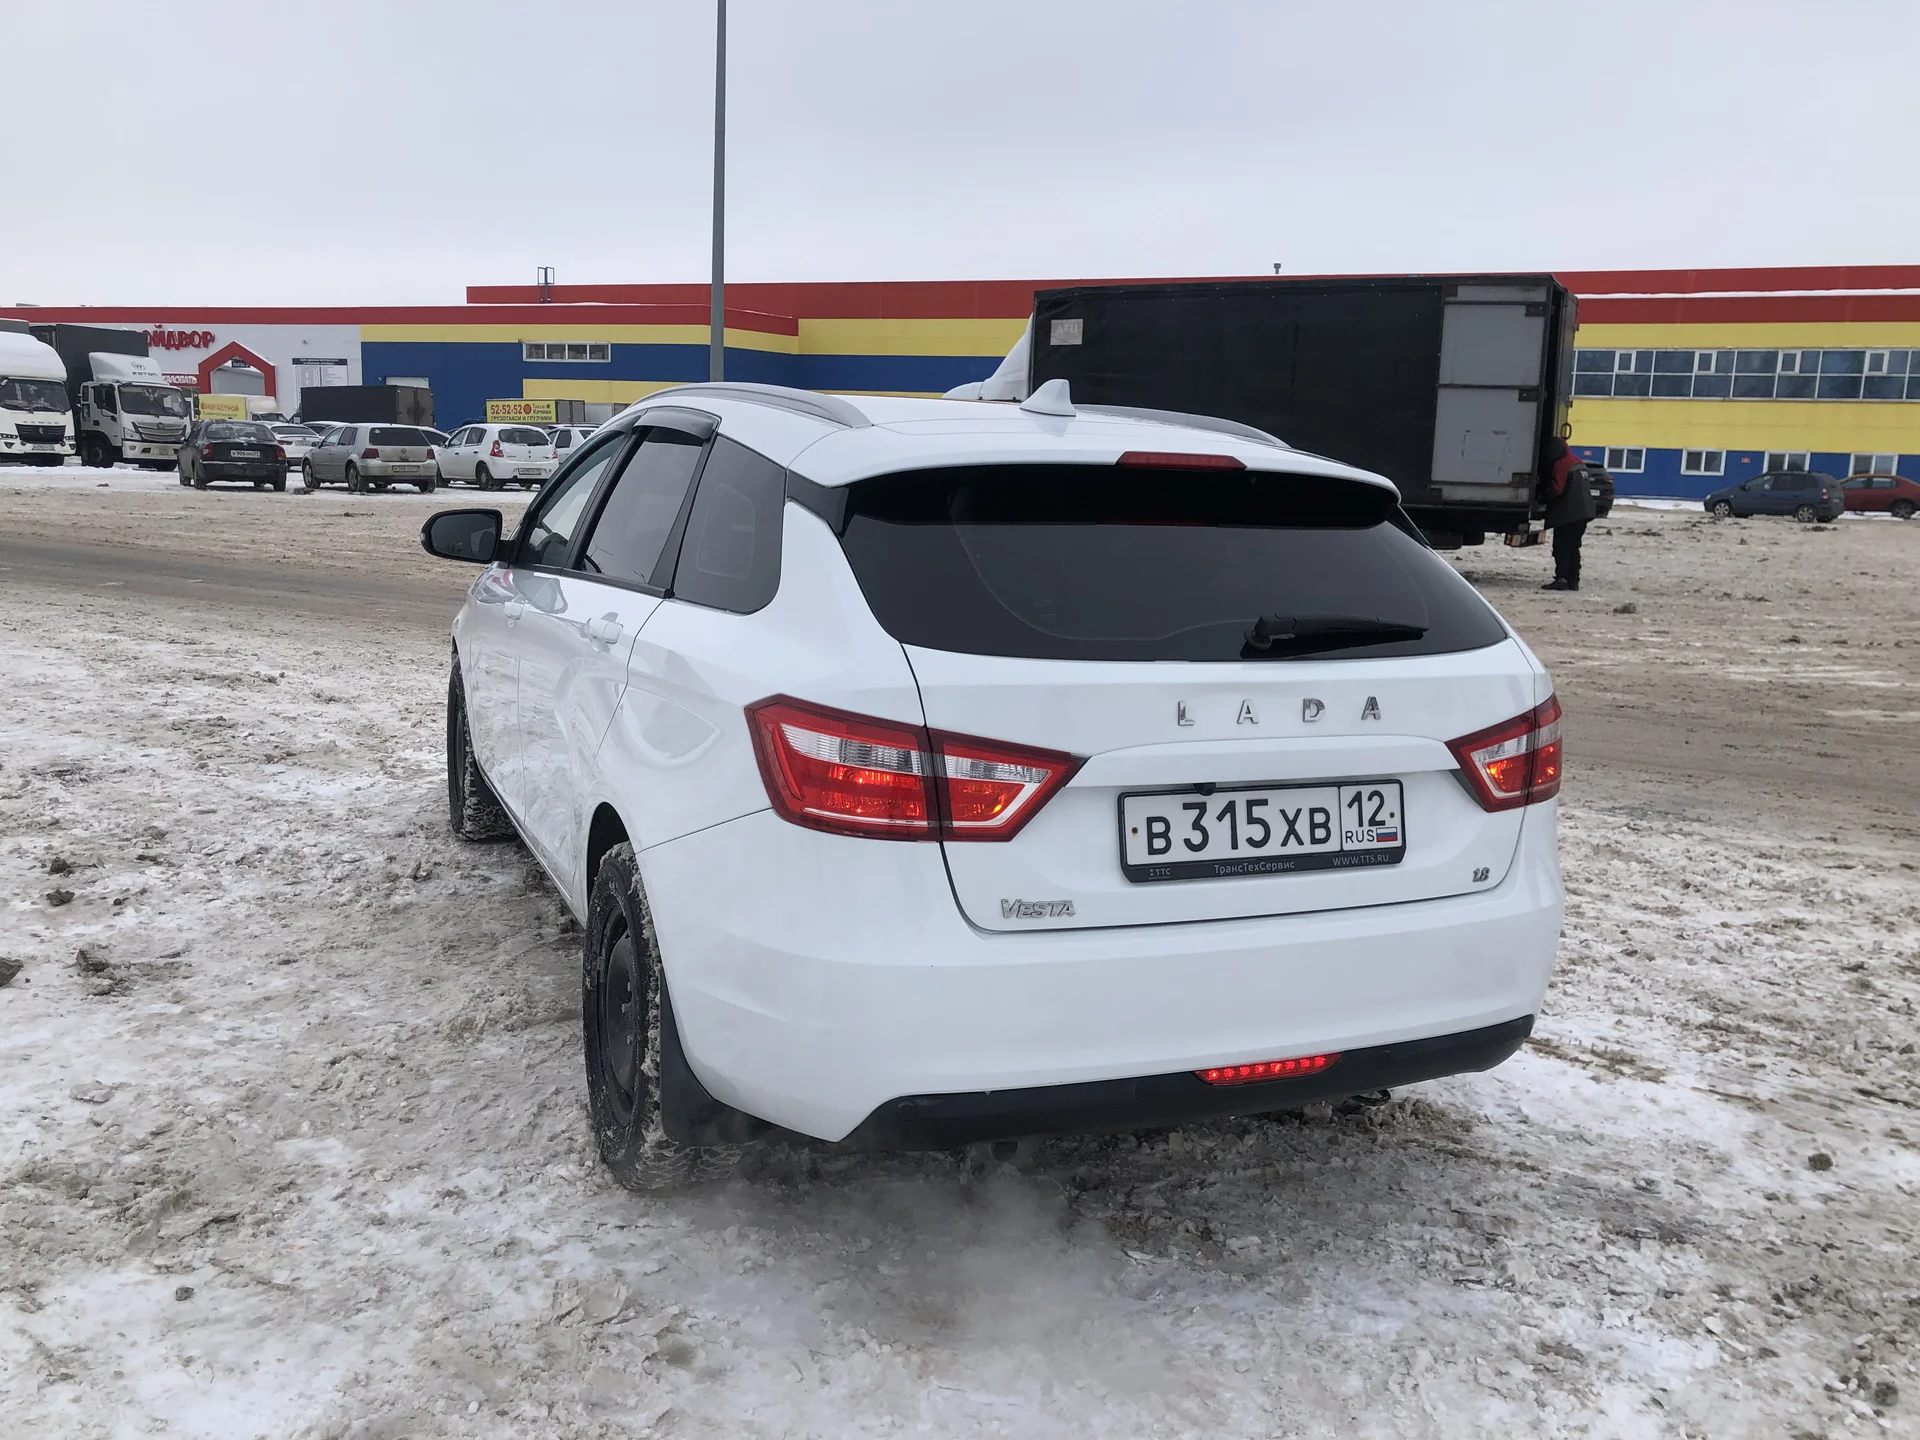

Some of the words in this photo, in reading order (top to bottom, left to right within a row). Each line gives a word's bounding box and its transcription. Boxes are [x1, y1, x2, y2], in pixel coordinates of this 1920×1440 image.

[490, 404, 523, 415] 52-52-52
[1177, 696, 1382, 726] LADA
[1347, 789, 1386, 828] 12
[1345, 829, 1375, 844] RUS
[1332, 854, 1389, 866] WWW.TTS.RU
[1155, 868, 1171, 876] ТТС
[1213, 861, 1296, 875] ТрансТехСервис
